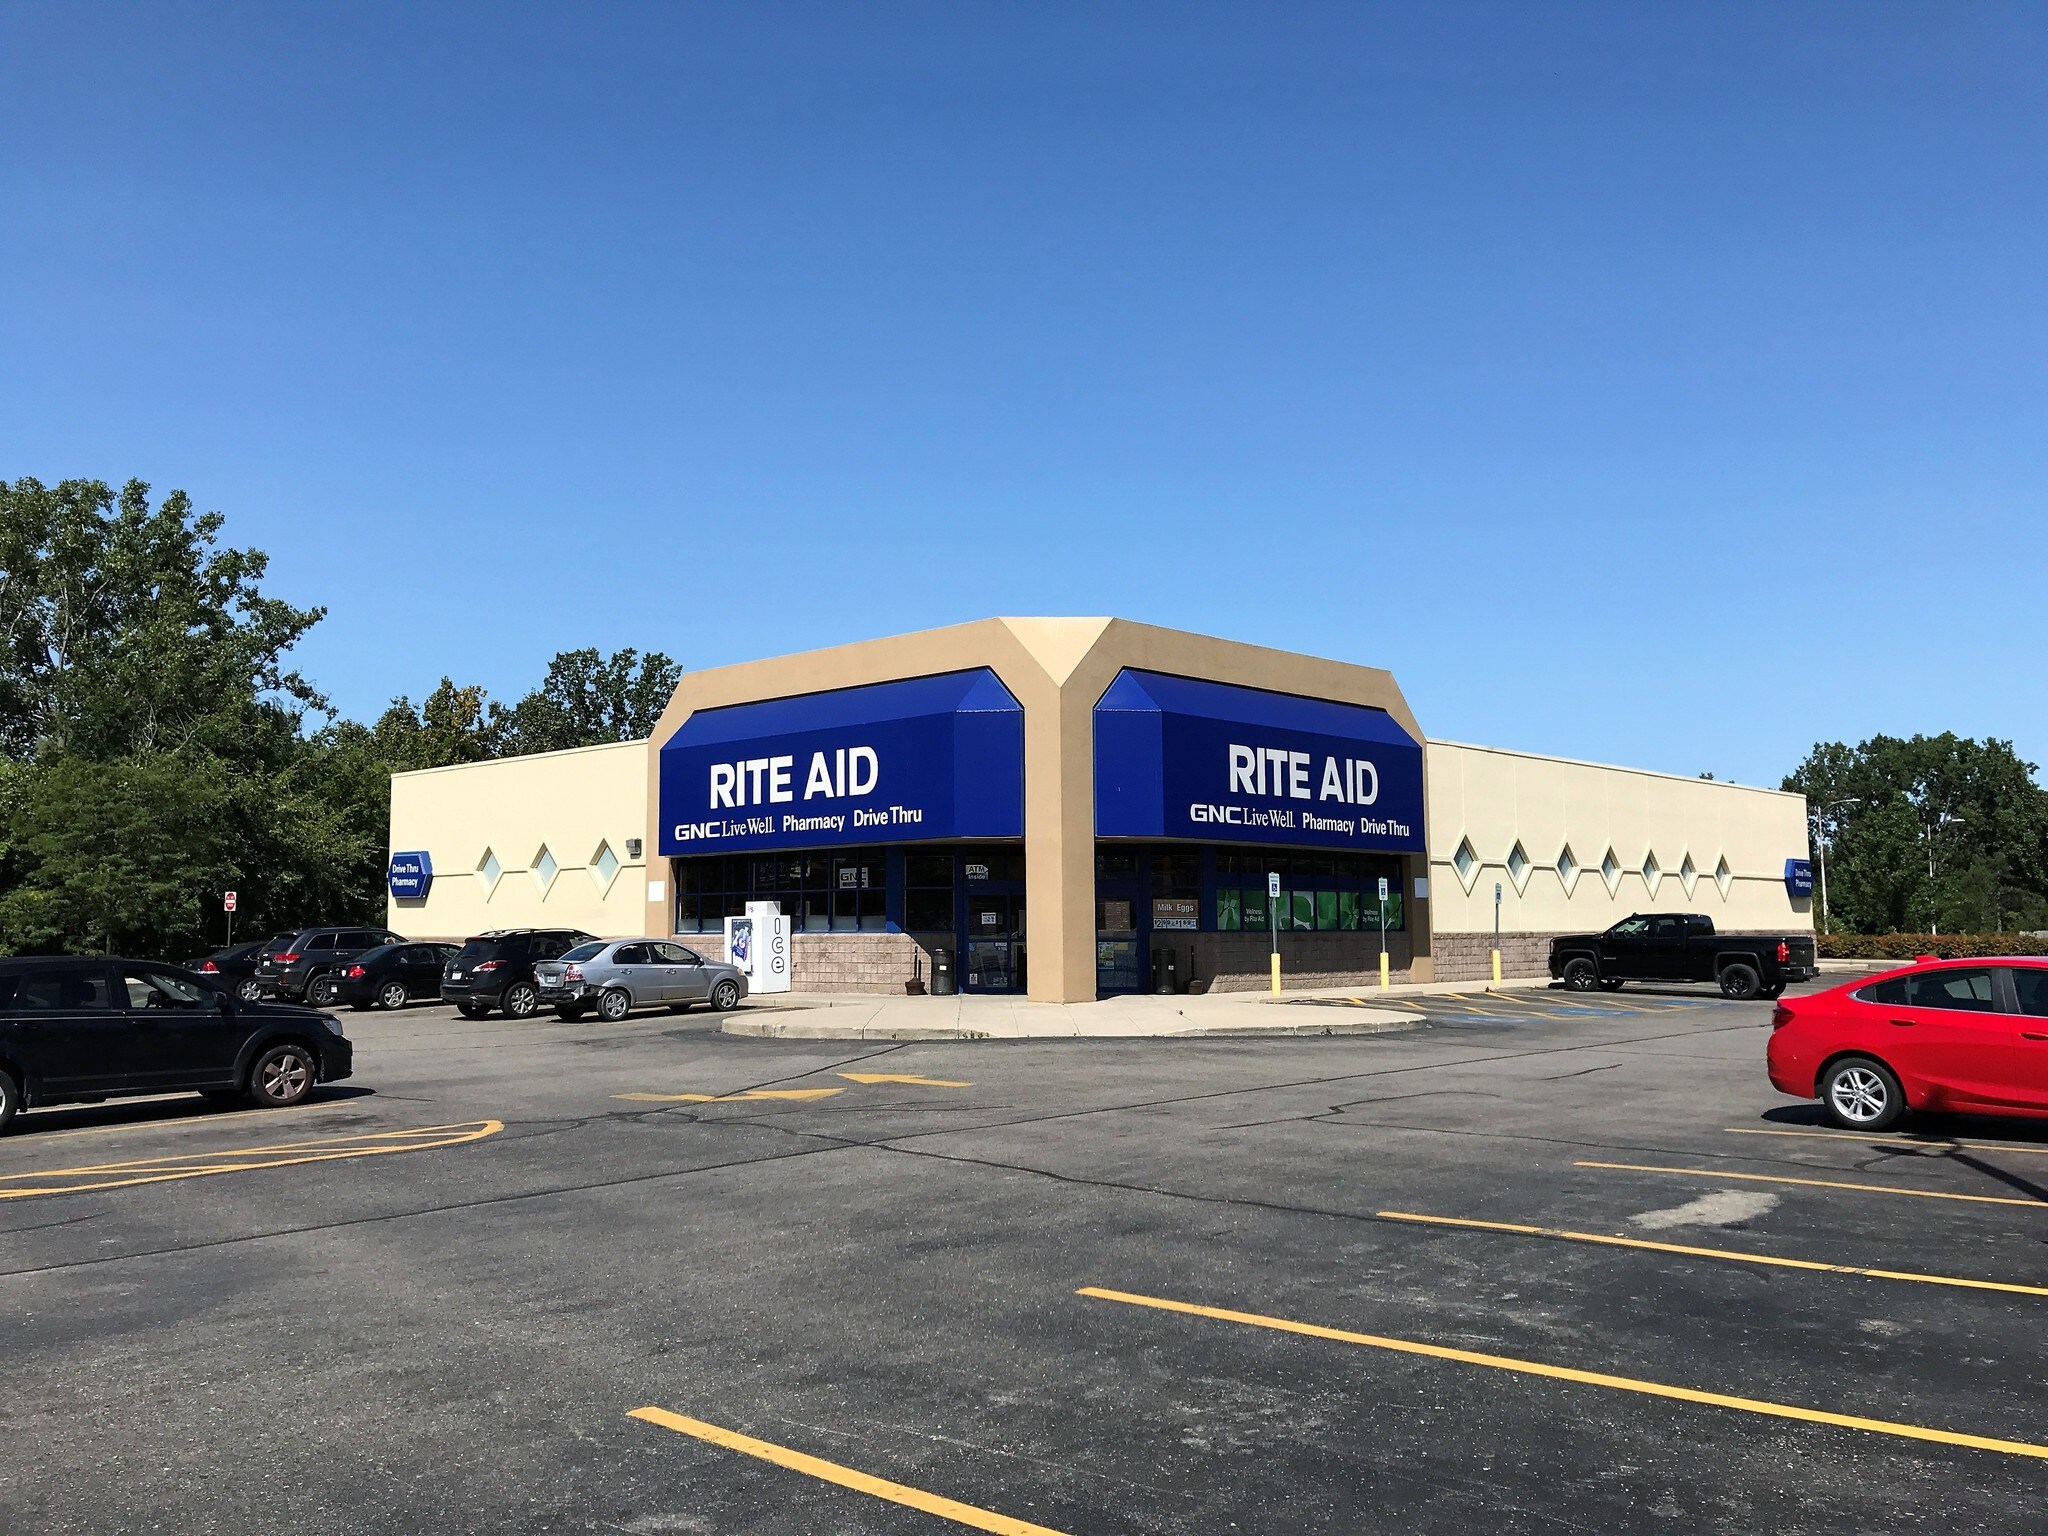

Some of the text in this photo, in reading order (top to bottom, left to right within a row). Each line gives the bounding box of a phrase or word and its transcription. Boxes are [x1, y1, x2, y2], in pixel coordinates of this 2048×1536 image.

[711, 746, 878, 810] RITE AID
[1229, 743, 1379, 806] RITE AID
[674, 821, 721, 841] GNC
[721, 819, 747, 838] Live
[782, 814, 846, 833] Pharmacy
[853, 808, 889, 827] Drive
[889, 805, 922, 824] Thru
[1190, 803, 1242, 825] GNC
[1242, 807, 1269, 827] Live
[1302, 812, 1355, 837] Pharmacy
[1360, 817, 1387, 835] Drive
[1386, 819, 1410, 837] Thru
[392, 863, 419, 873] Drive Thru
[969, 865, 985, 873] ATM
[391, 876, 419, 889] Pharmacy
[1157, 903, 1194, 913] Milk Eggs
